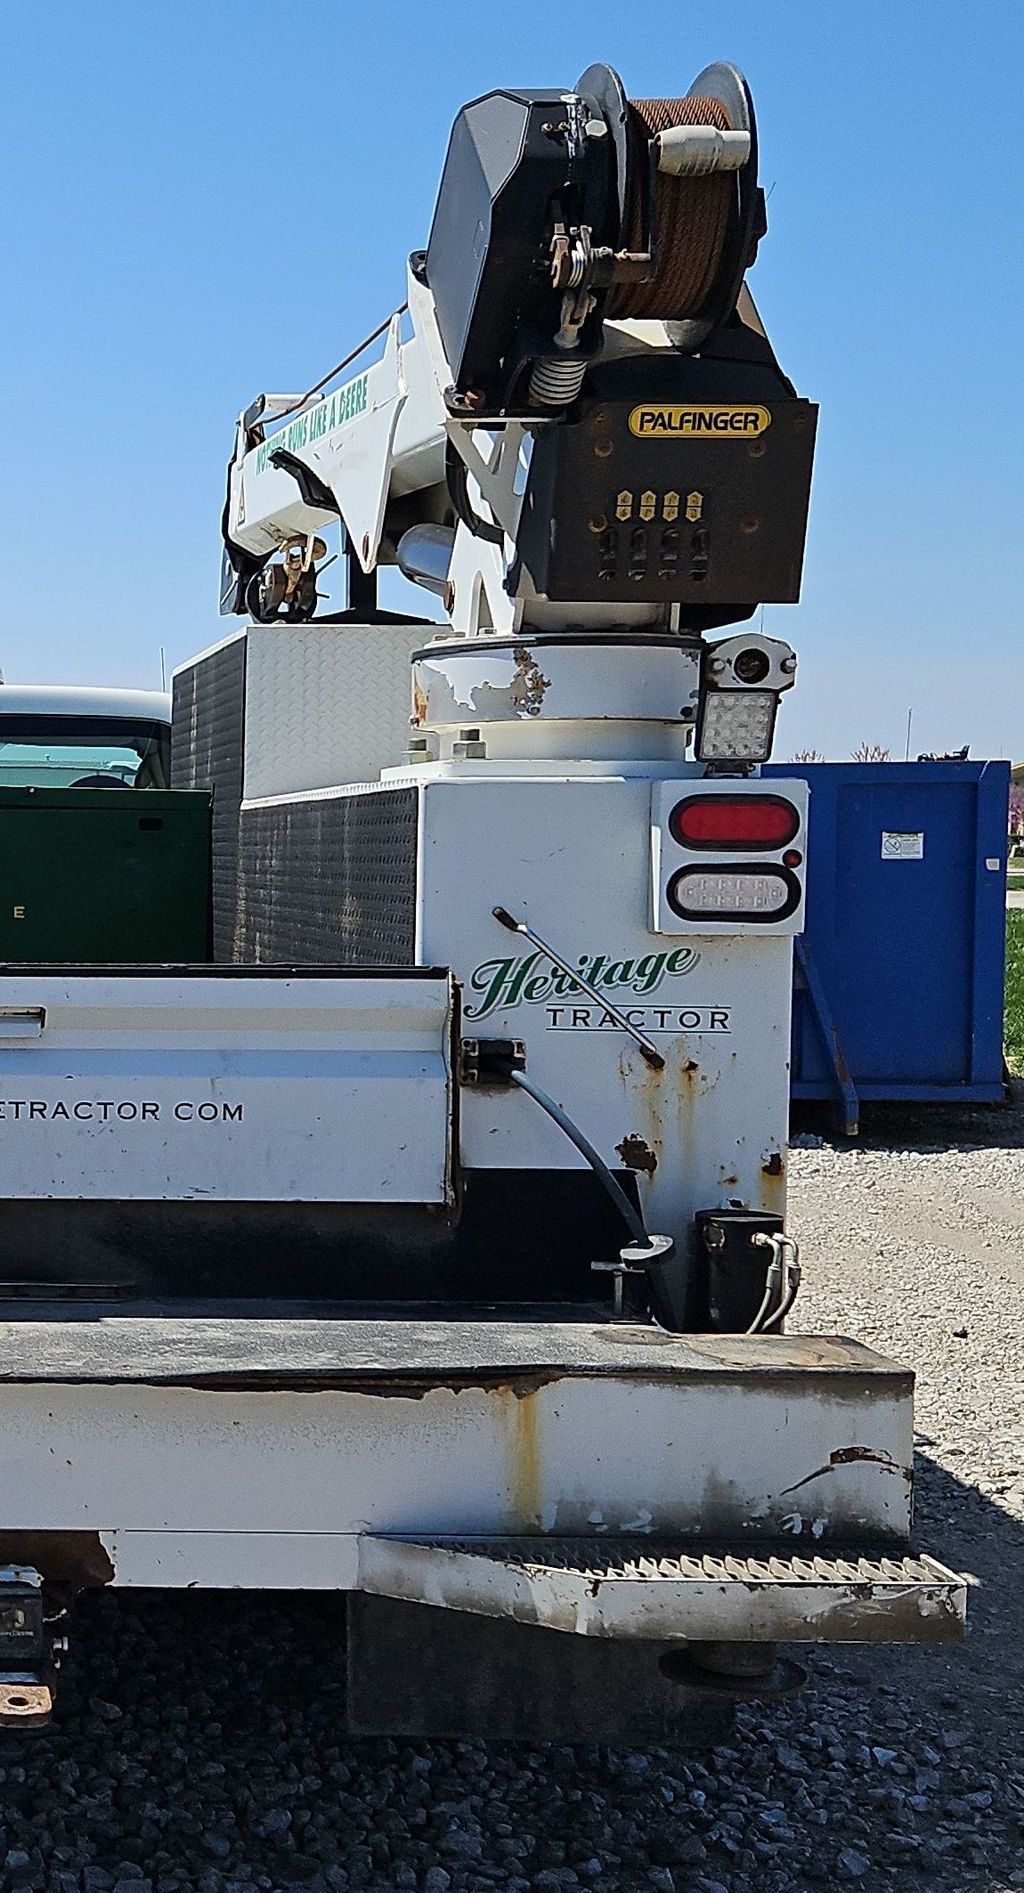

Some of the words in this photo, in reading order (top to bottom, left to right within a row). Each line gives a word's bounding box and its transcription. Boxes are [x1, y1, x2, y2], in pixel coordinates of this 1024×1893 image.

[287, 415, 308, 452] RUNS
[309, 404, 328, 442] LIKE
[329, 395, 337, 431] A
[339, 374, 369, 425] DEERE
[639, 411, 760, 432] PALFINGER
[462, 947, 696, 1020] Heritage
[546, 1008, 730, 1029] TRACTOR
[174, 1102, 243, 1121] COM
